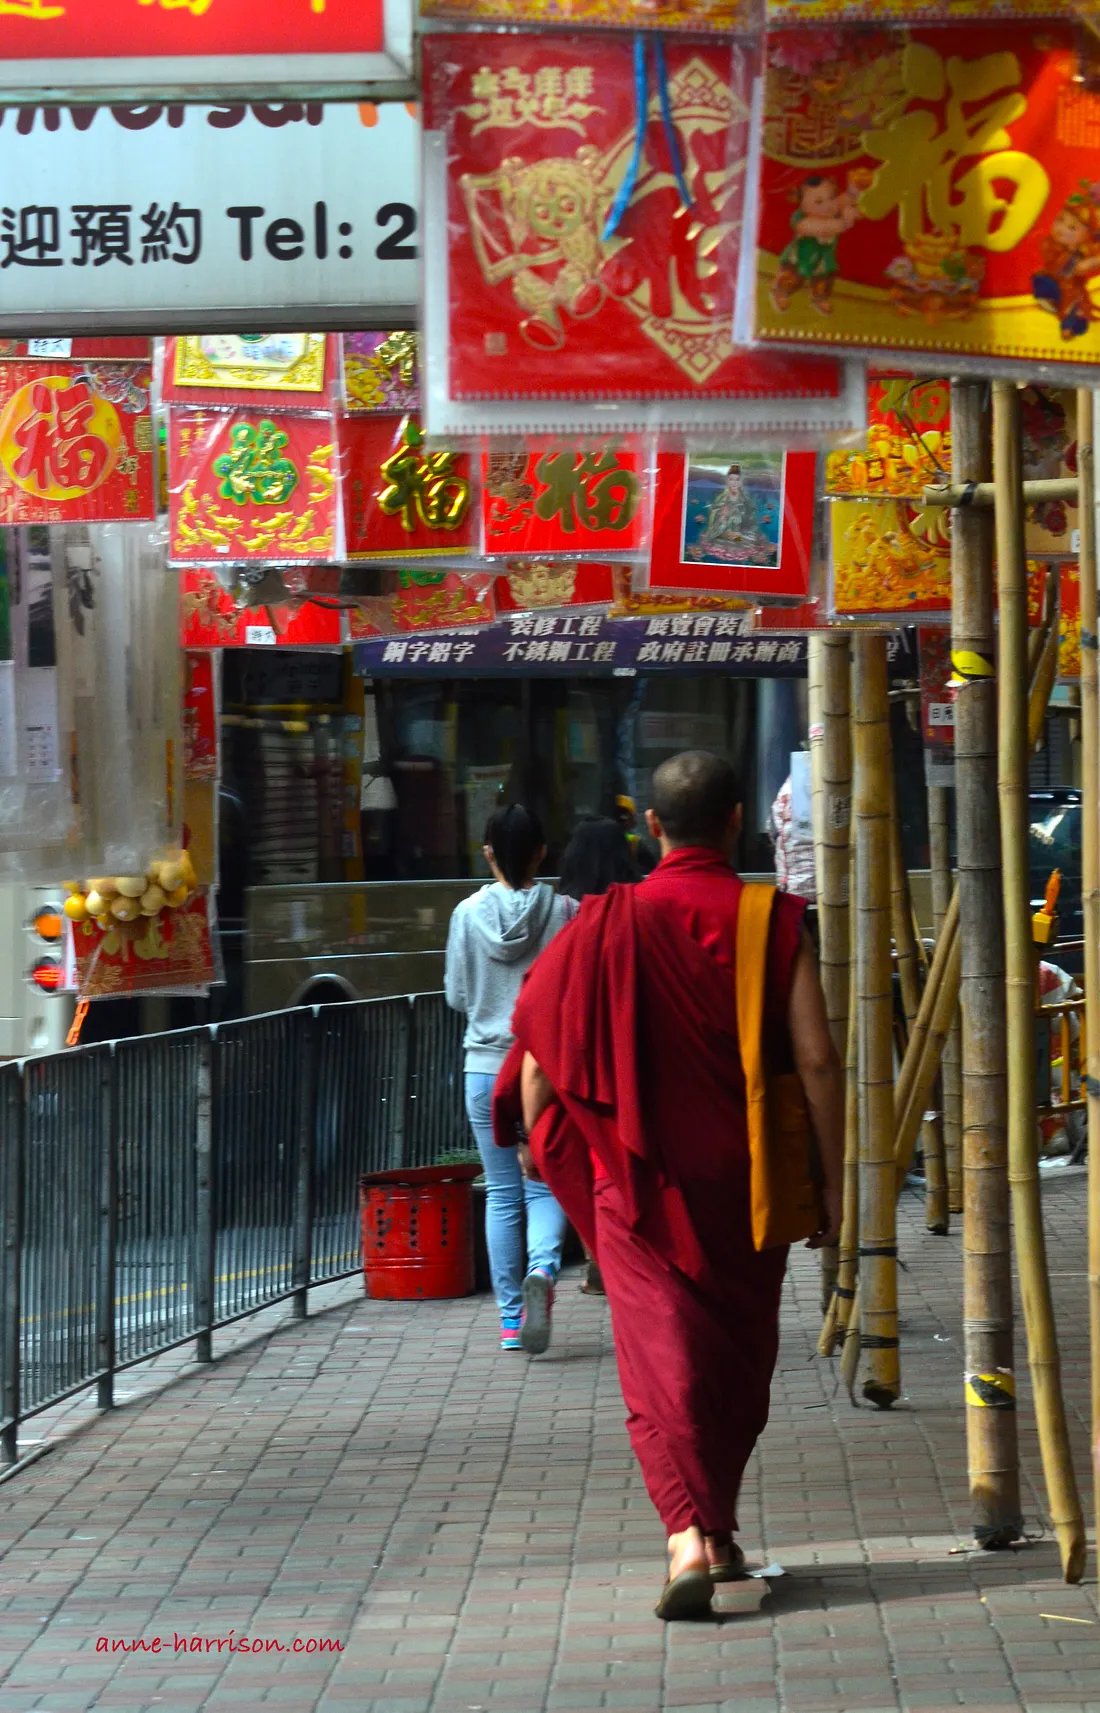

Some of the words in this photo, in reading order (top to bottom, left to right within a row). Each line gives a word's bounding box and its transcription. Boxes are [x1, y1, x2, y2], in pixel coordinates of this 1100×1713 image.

[0, 201, 201, 268] 迎預約
[226, 200, 354, 262] Tel:
[374, 202, 419, 261] 2
[12, 381, 112, 491] 福
[510, 617, 602, 637] 裝修工程
